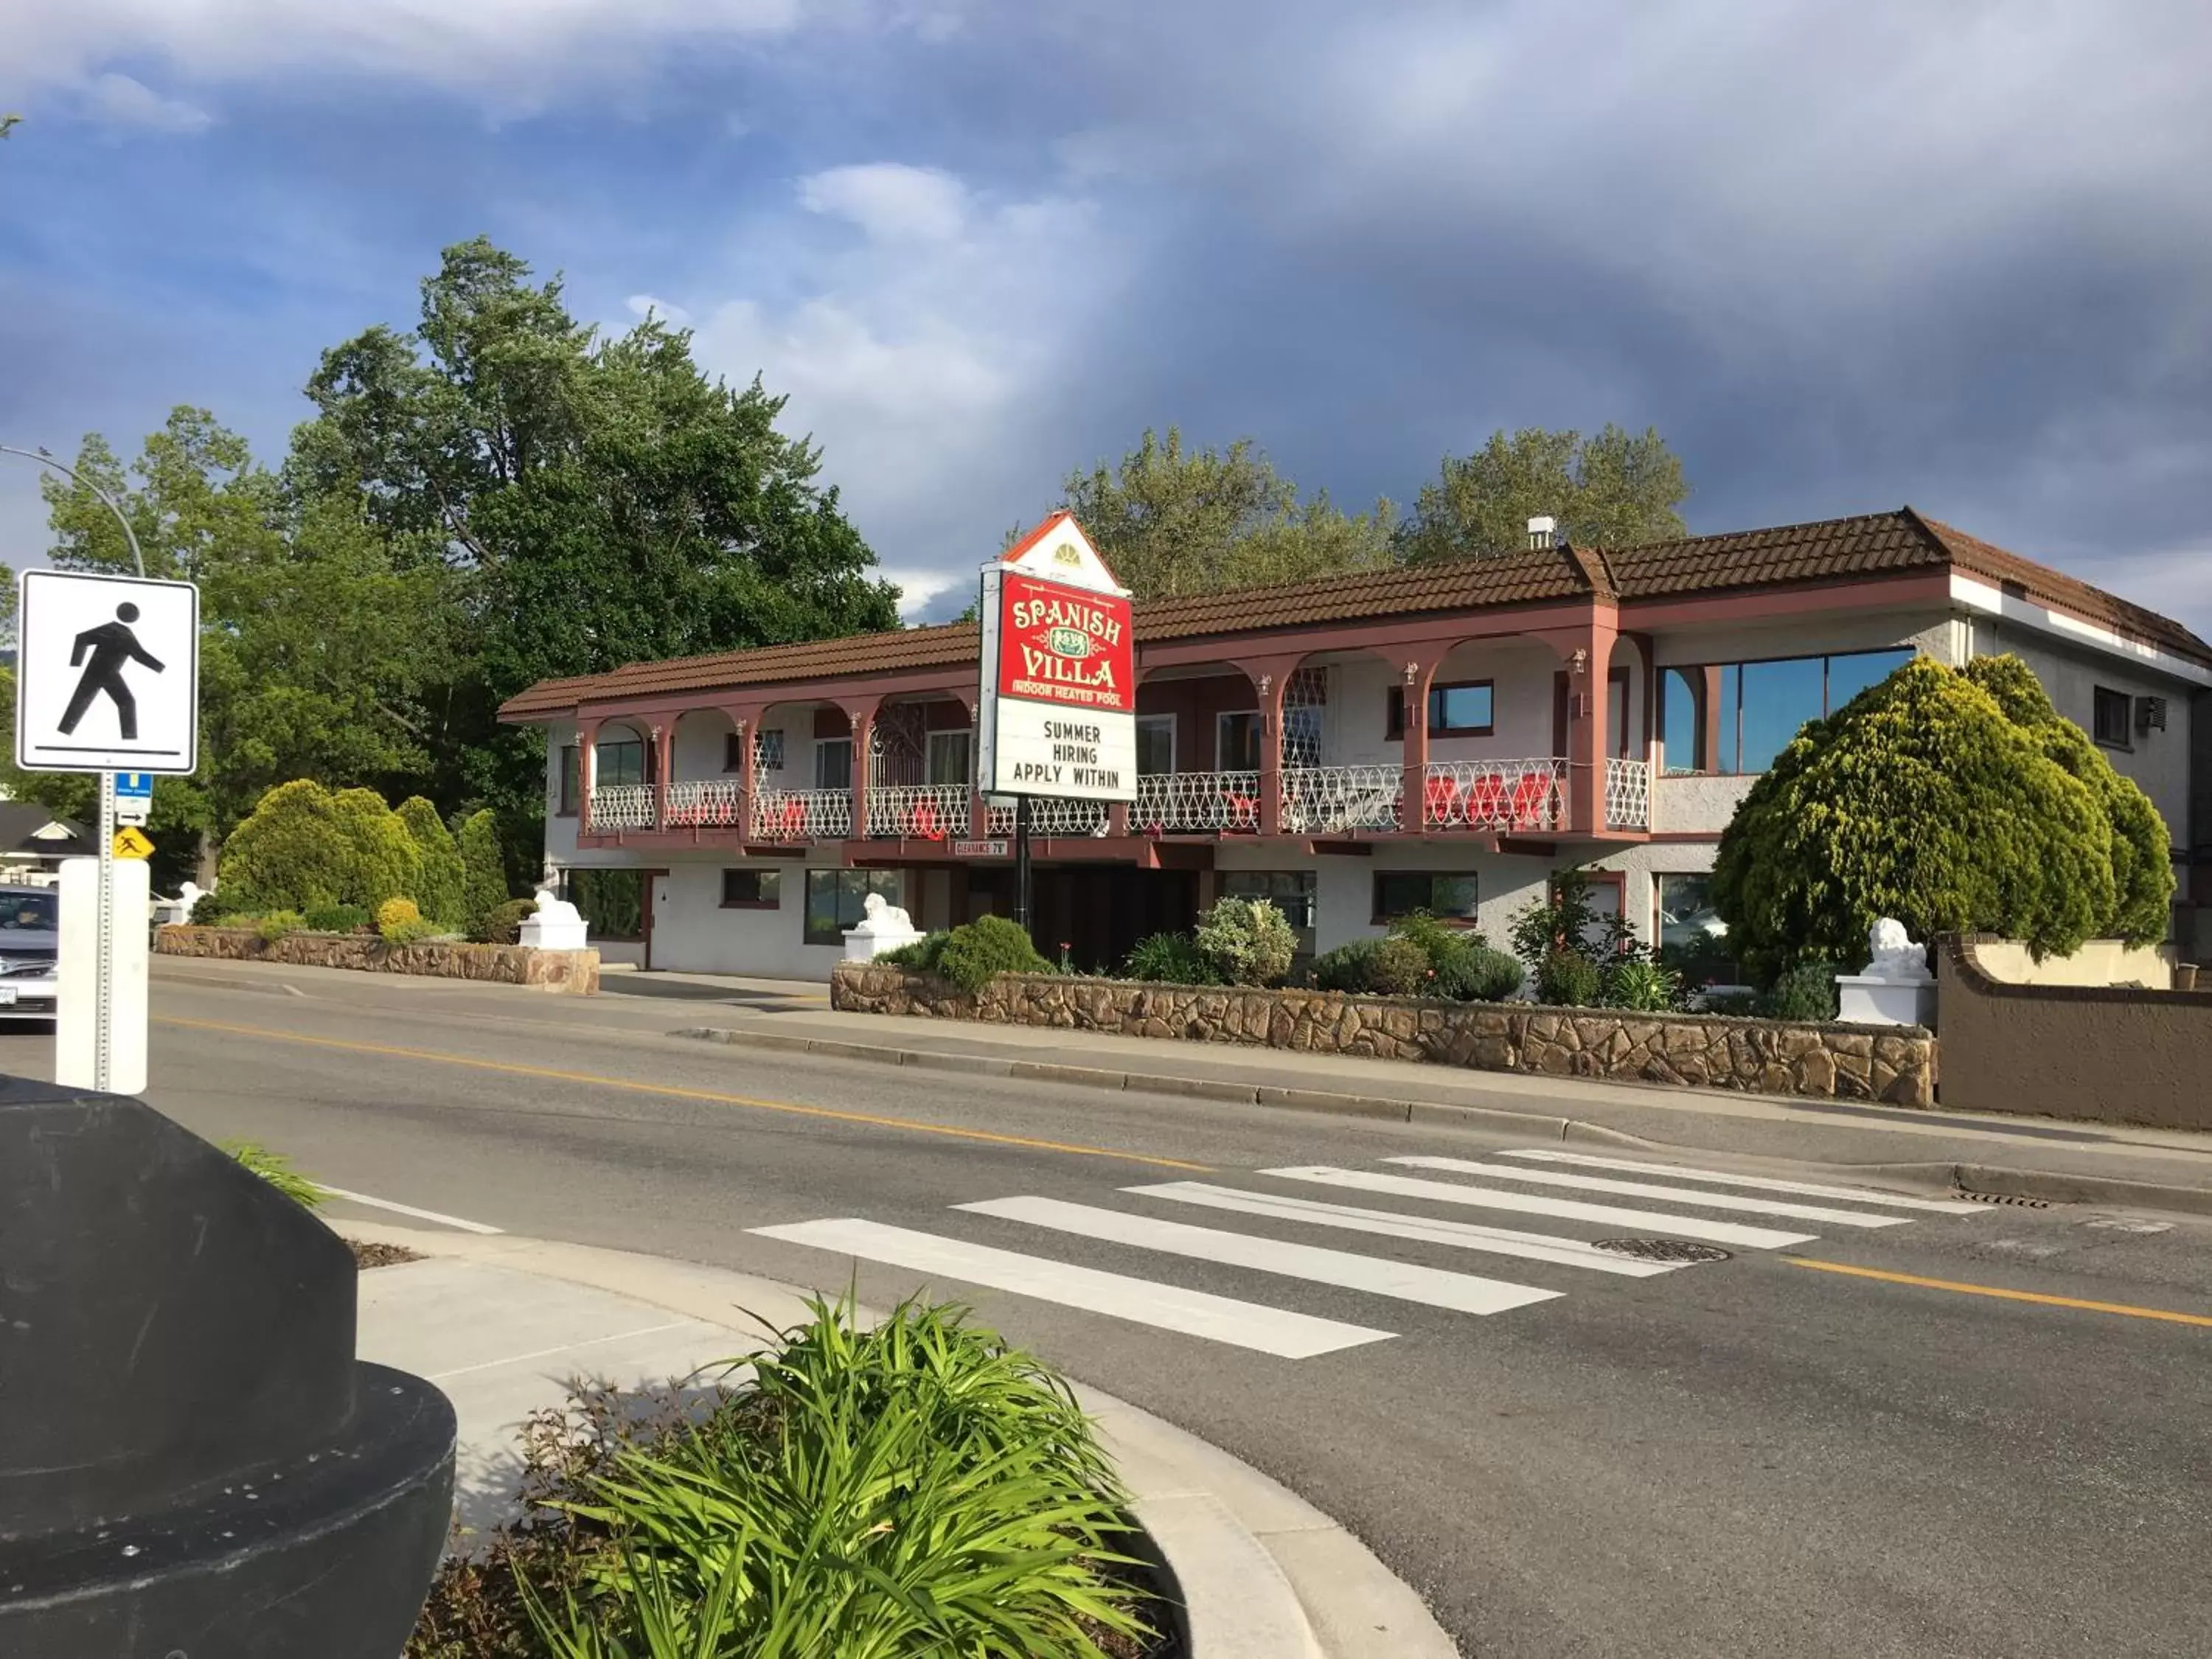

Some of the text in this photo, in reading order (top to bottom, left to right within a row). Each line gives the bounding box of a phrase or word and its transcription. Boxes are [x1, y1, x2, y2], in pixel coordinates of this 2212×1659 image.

[1012, 599, 1121, 647] SPANISH
[1020, 643, 1116, 688] VILLA
[1012, 679, 1121, 706] INDOOR HEATED POOL
[1044, 720, 1101, 744] SUMMER
[1053, 744, 1098, 765] HIRING
[1014, 762, 1119, 788] APPLY WITHIN
